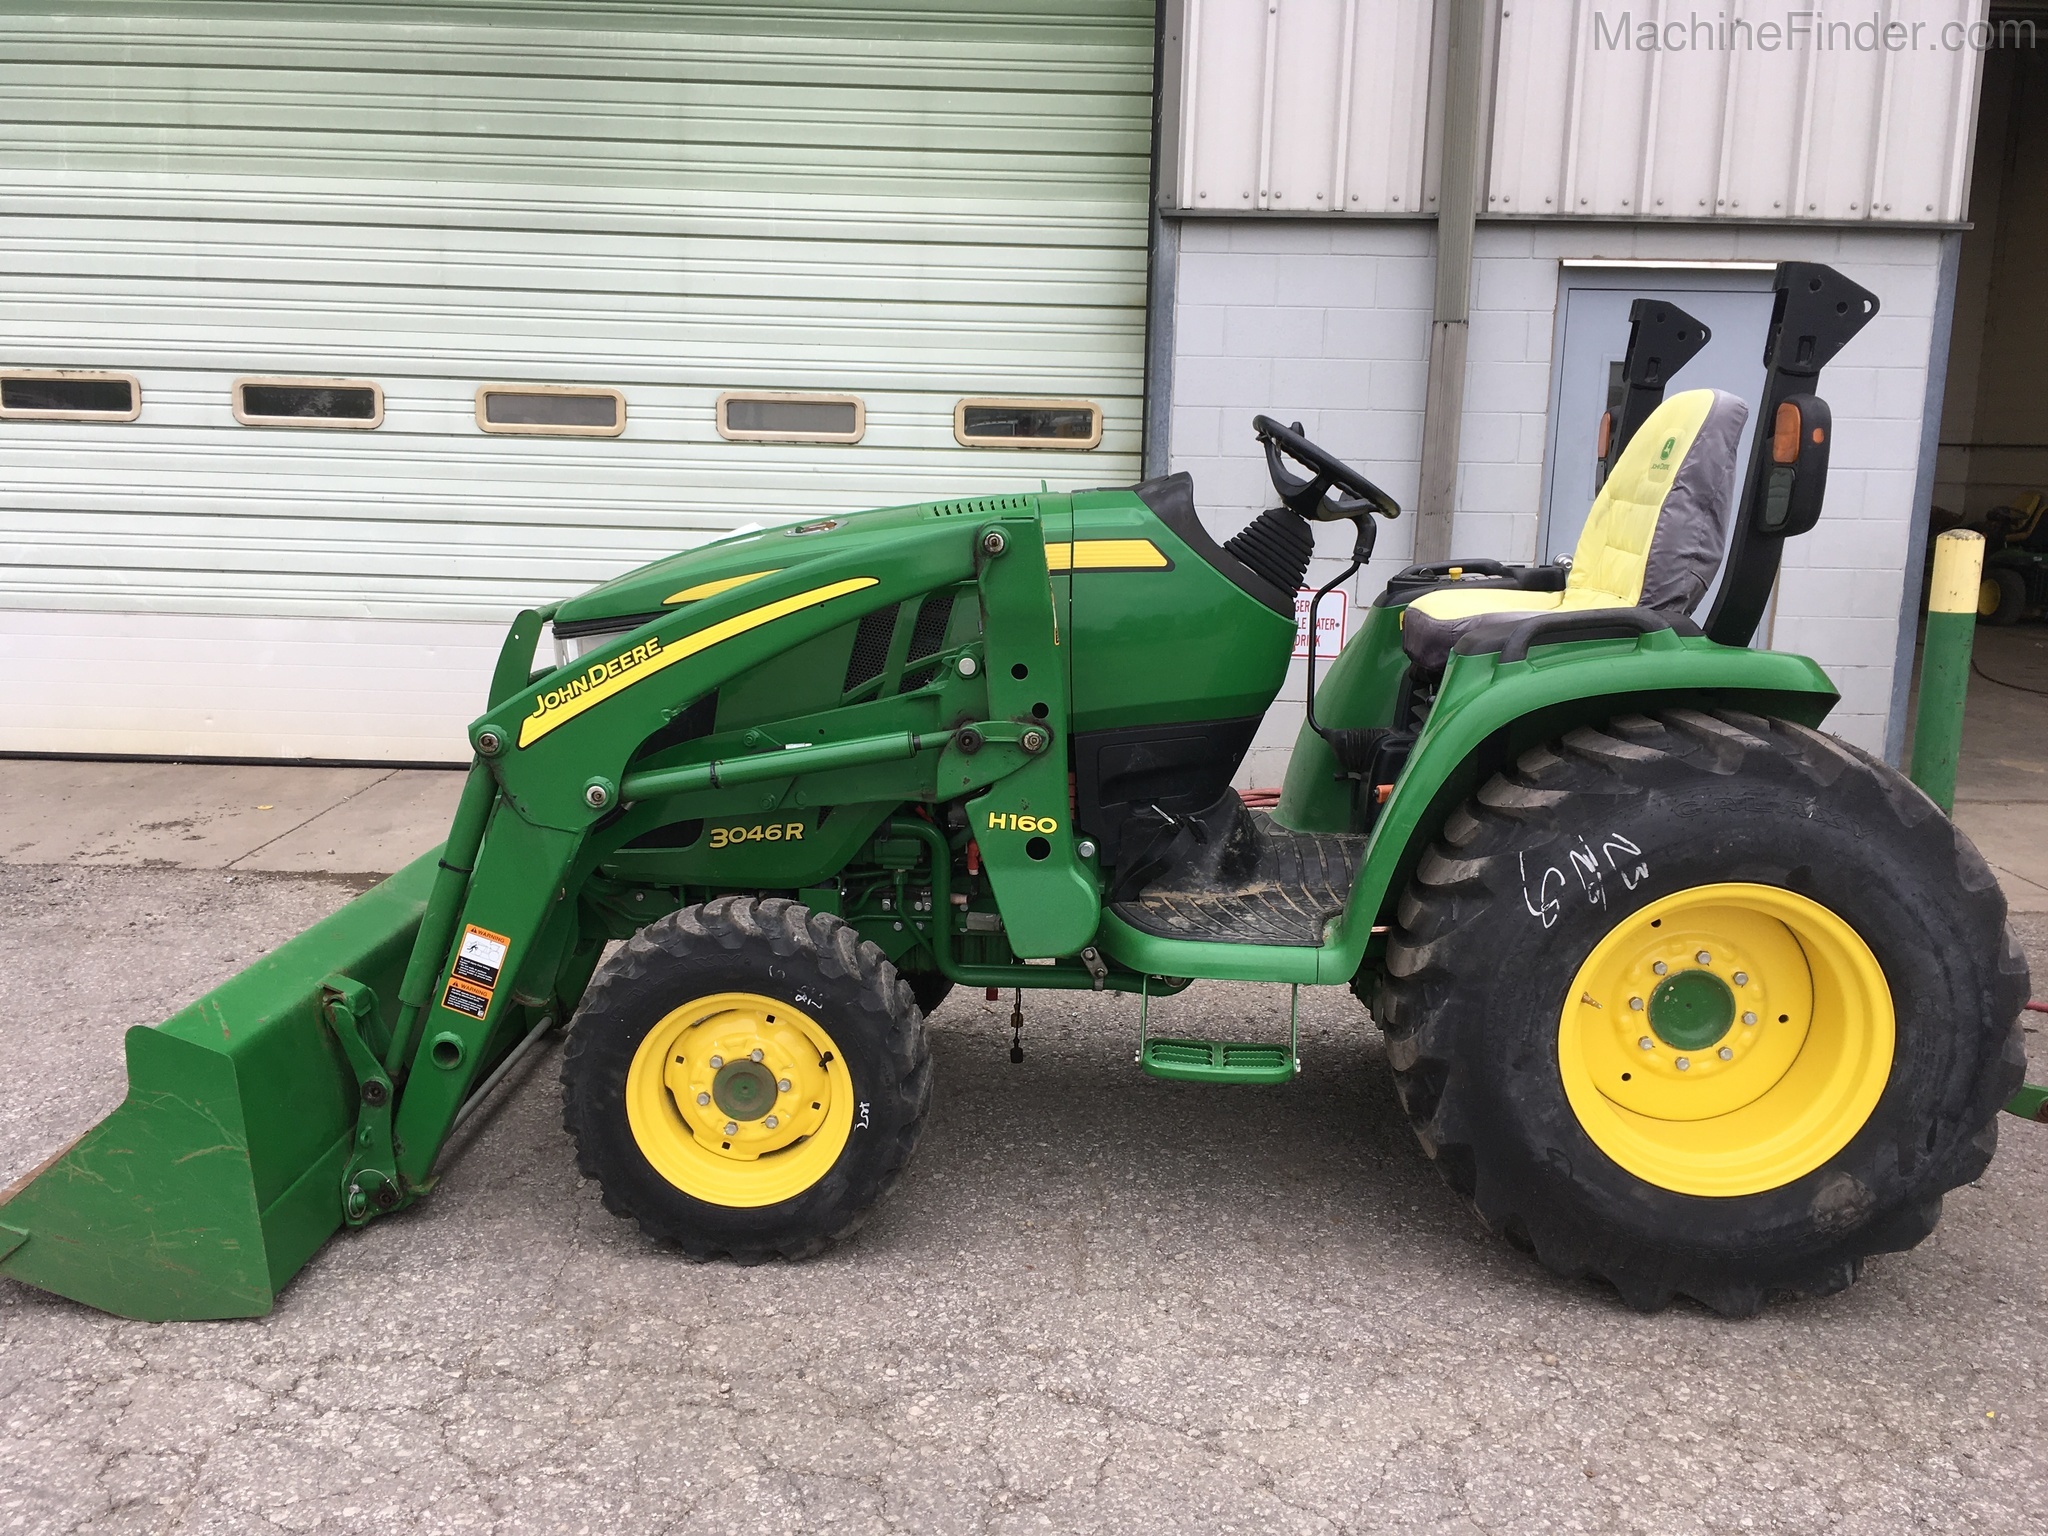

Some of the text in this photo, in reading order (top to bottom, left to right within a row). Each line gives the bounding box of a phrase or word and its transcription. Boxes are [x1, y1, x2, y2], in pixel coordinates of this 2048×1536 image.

[1295, 600, 1310, 612] GER
[1316, 618, 1335, 631] ATER
[1295, 635, 1321, 647] DRIK
[532, 637, 662, 717] JOHN DEERE
[988, 812, 1058, 834] H160
[709, 823, 804, 849] 3046R
[477, 930, 505, 943] WARNING
[460, 983, 488, 997] WARNING
